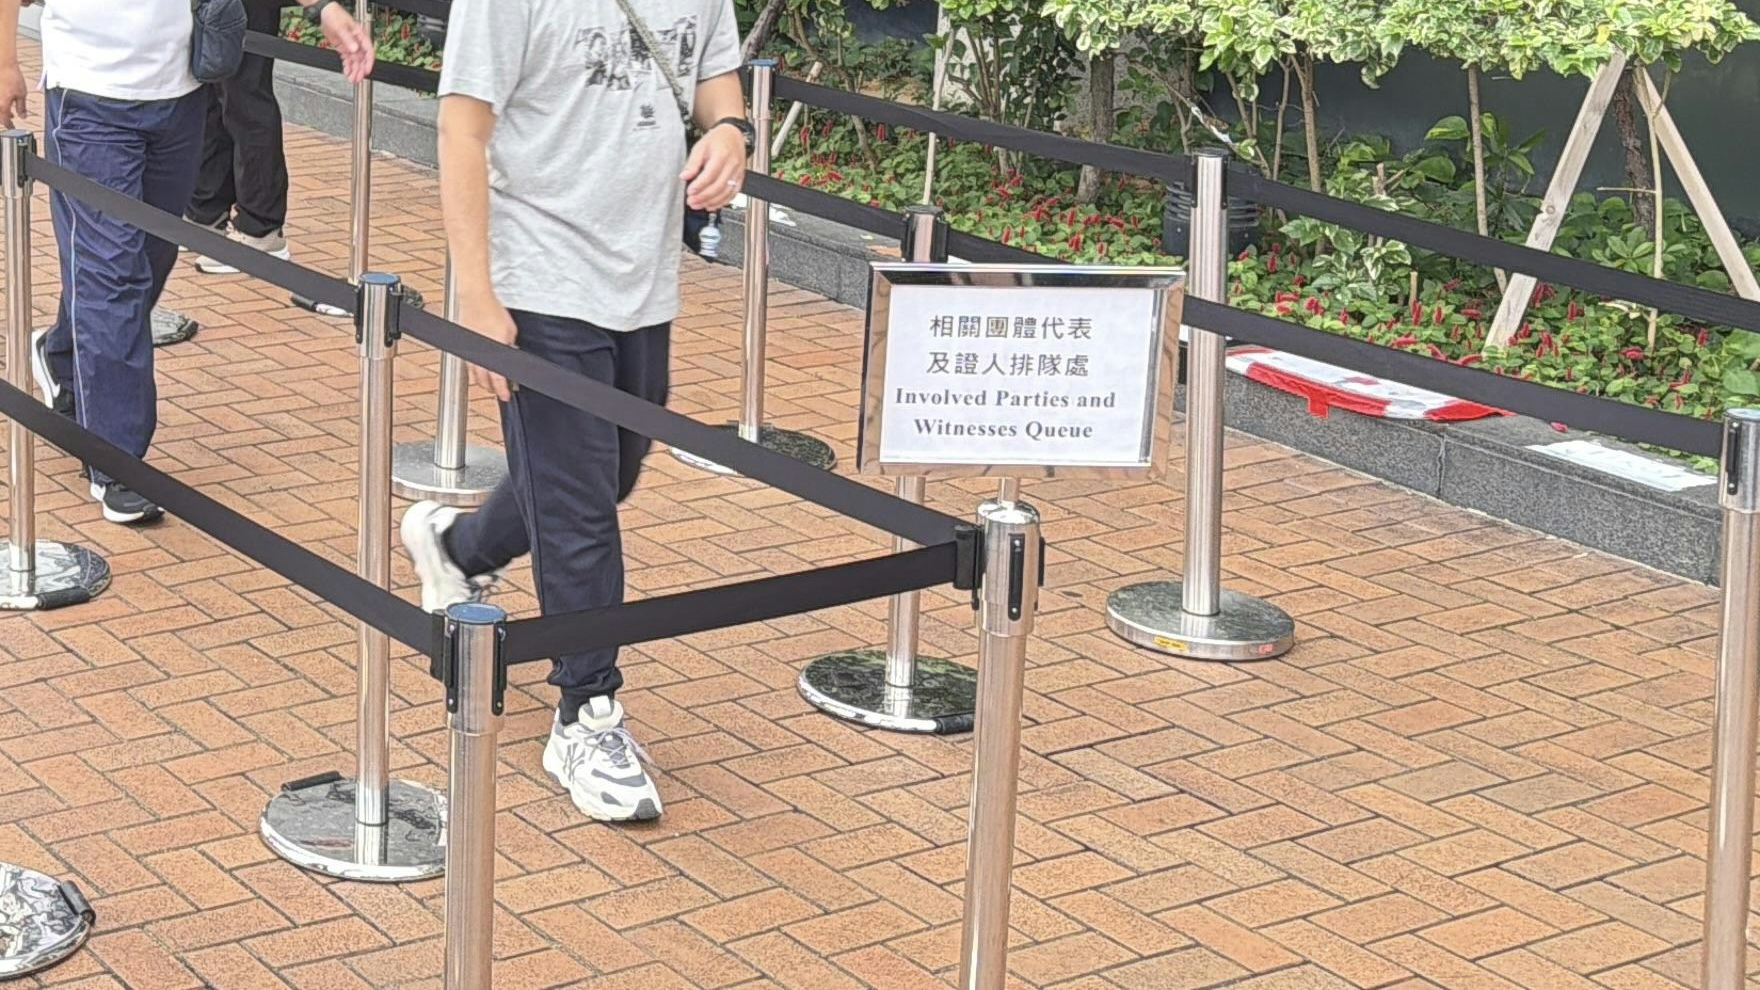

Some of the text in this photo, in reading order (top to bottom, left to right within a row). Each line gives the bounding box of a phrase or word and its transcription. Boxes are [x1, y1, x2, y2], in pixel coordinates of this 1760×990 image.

[929, 314, 1093, 340] 相關團體代表
[926, 351, 1090, 377] 及證人排隊處
[895, 387, 1116, 408] Involved Parties and
[913, 418, 1094, 441] Witnesses Queue
